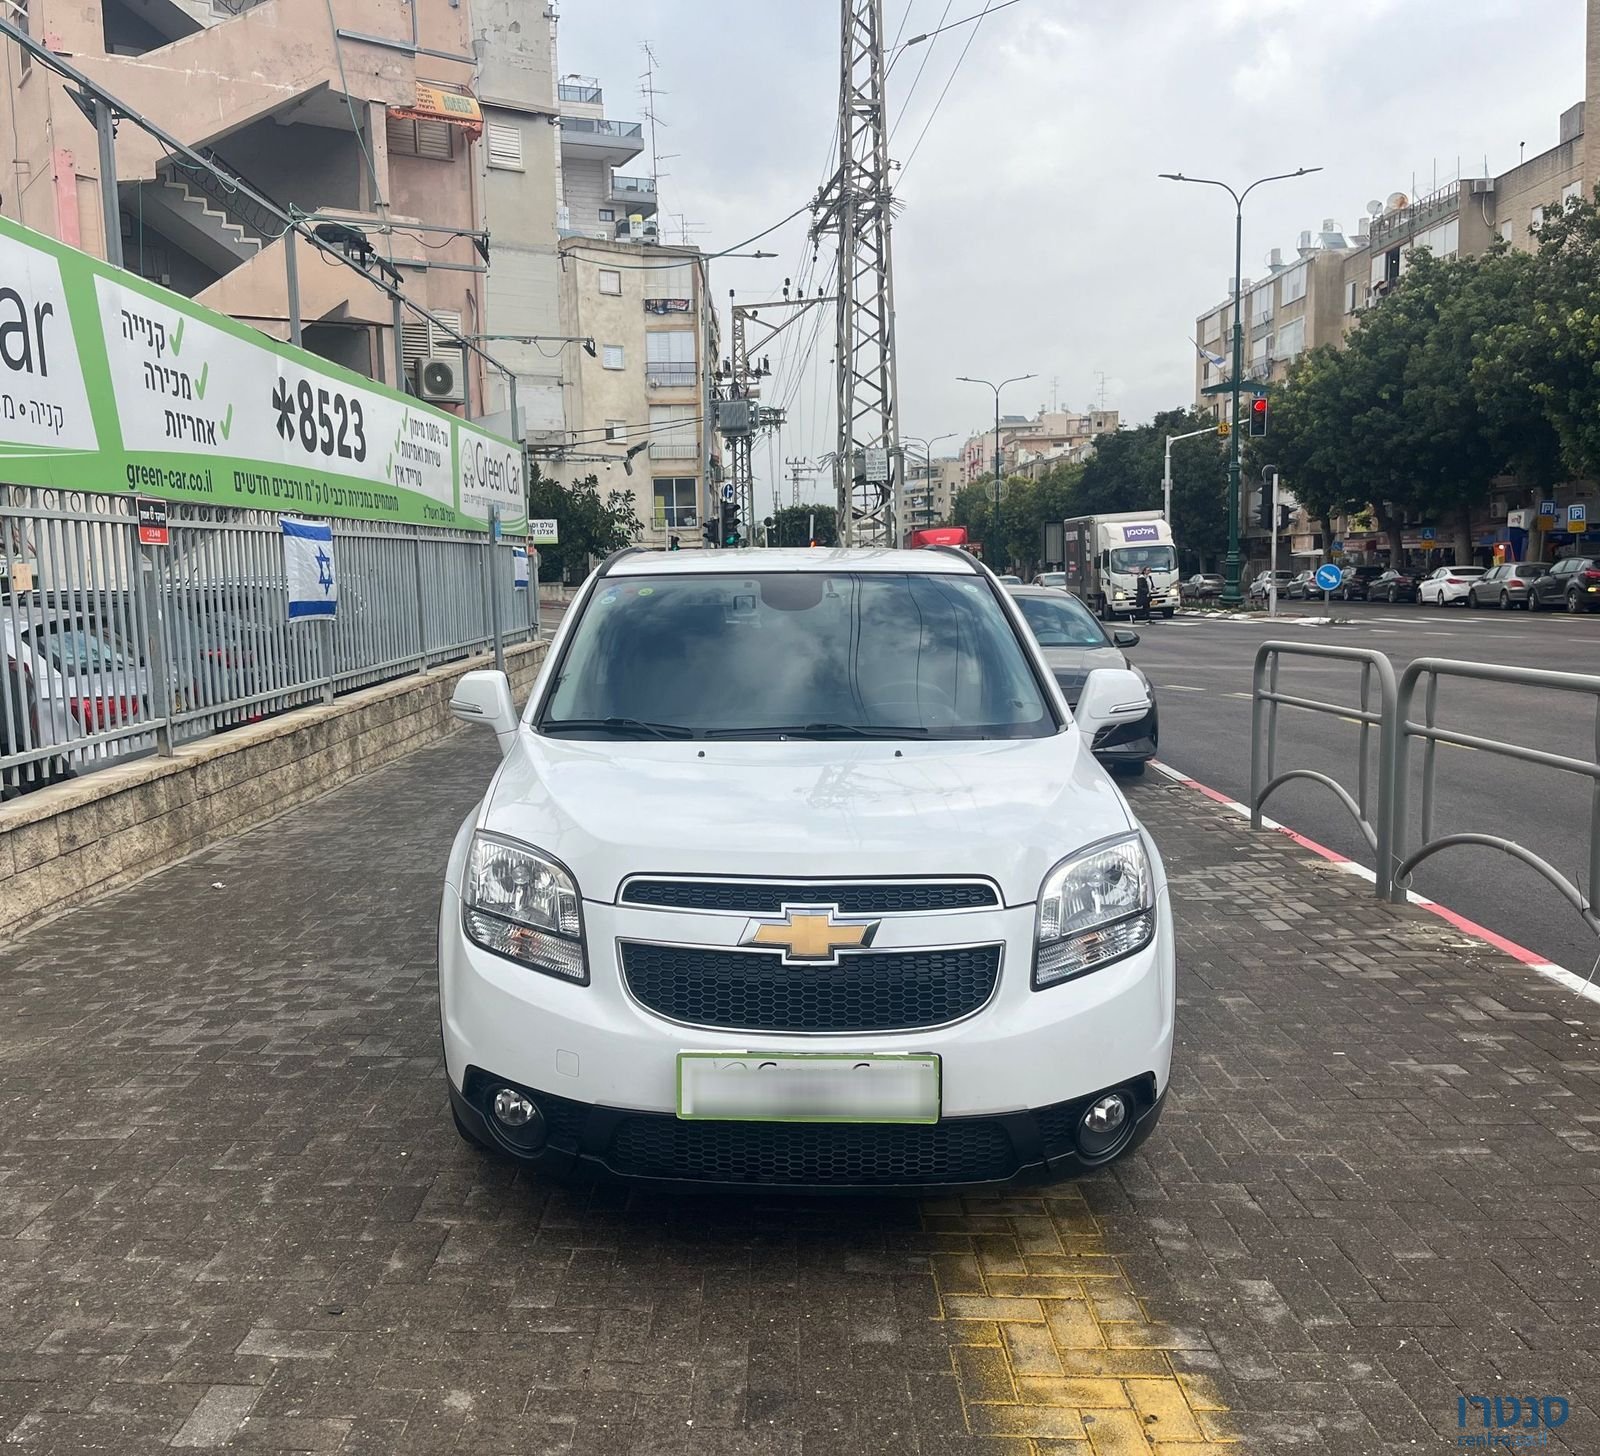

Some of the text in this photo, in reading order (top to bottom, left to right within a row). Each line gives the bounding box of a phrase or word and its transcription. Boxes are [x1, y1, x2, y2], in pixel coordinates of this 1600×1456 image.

[121, 309, 166, 358] קנייה
[143, 361, 192, 401] מכירה
[30, 400, 64, 436] קניה
[164, 409, 217, 446] אחריות
[409, 417, 425, 440] מימון
[126, 463, 213, 493] green-car.co.il
[394, 464, 405, 487] אין
[475, 441, 520, 496] Green Car
[233, 470, 271, 496] חדשים
[271, 476, 303, 501] ורכבים
[323, 482, 329, 504] 0
[330, 486, 347, 507] רכבי
[347, 489, 373, 509] במכירת
[1126, 526, 1155, 538] אלטמן
